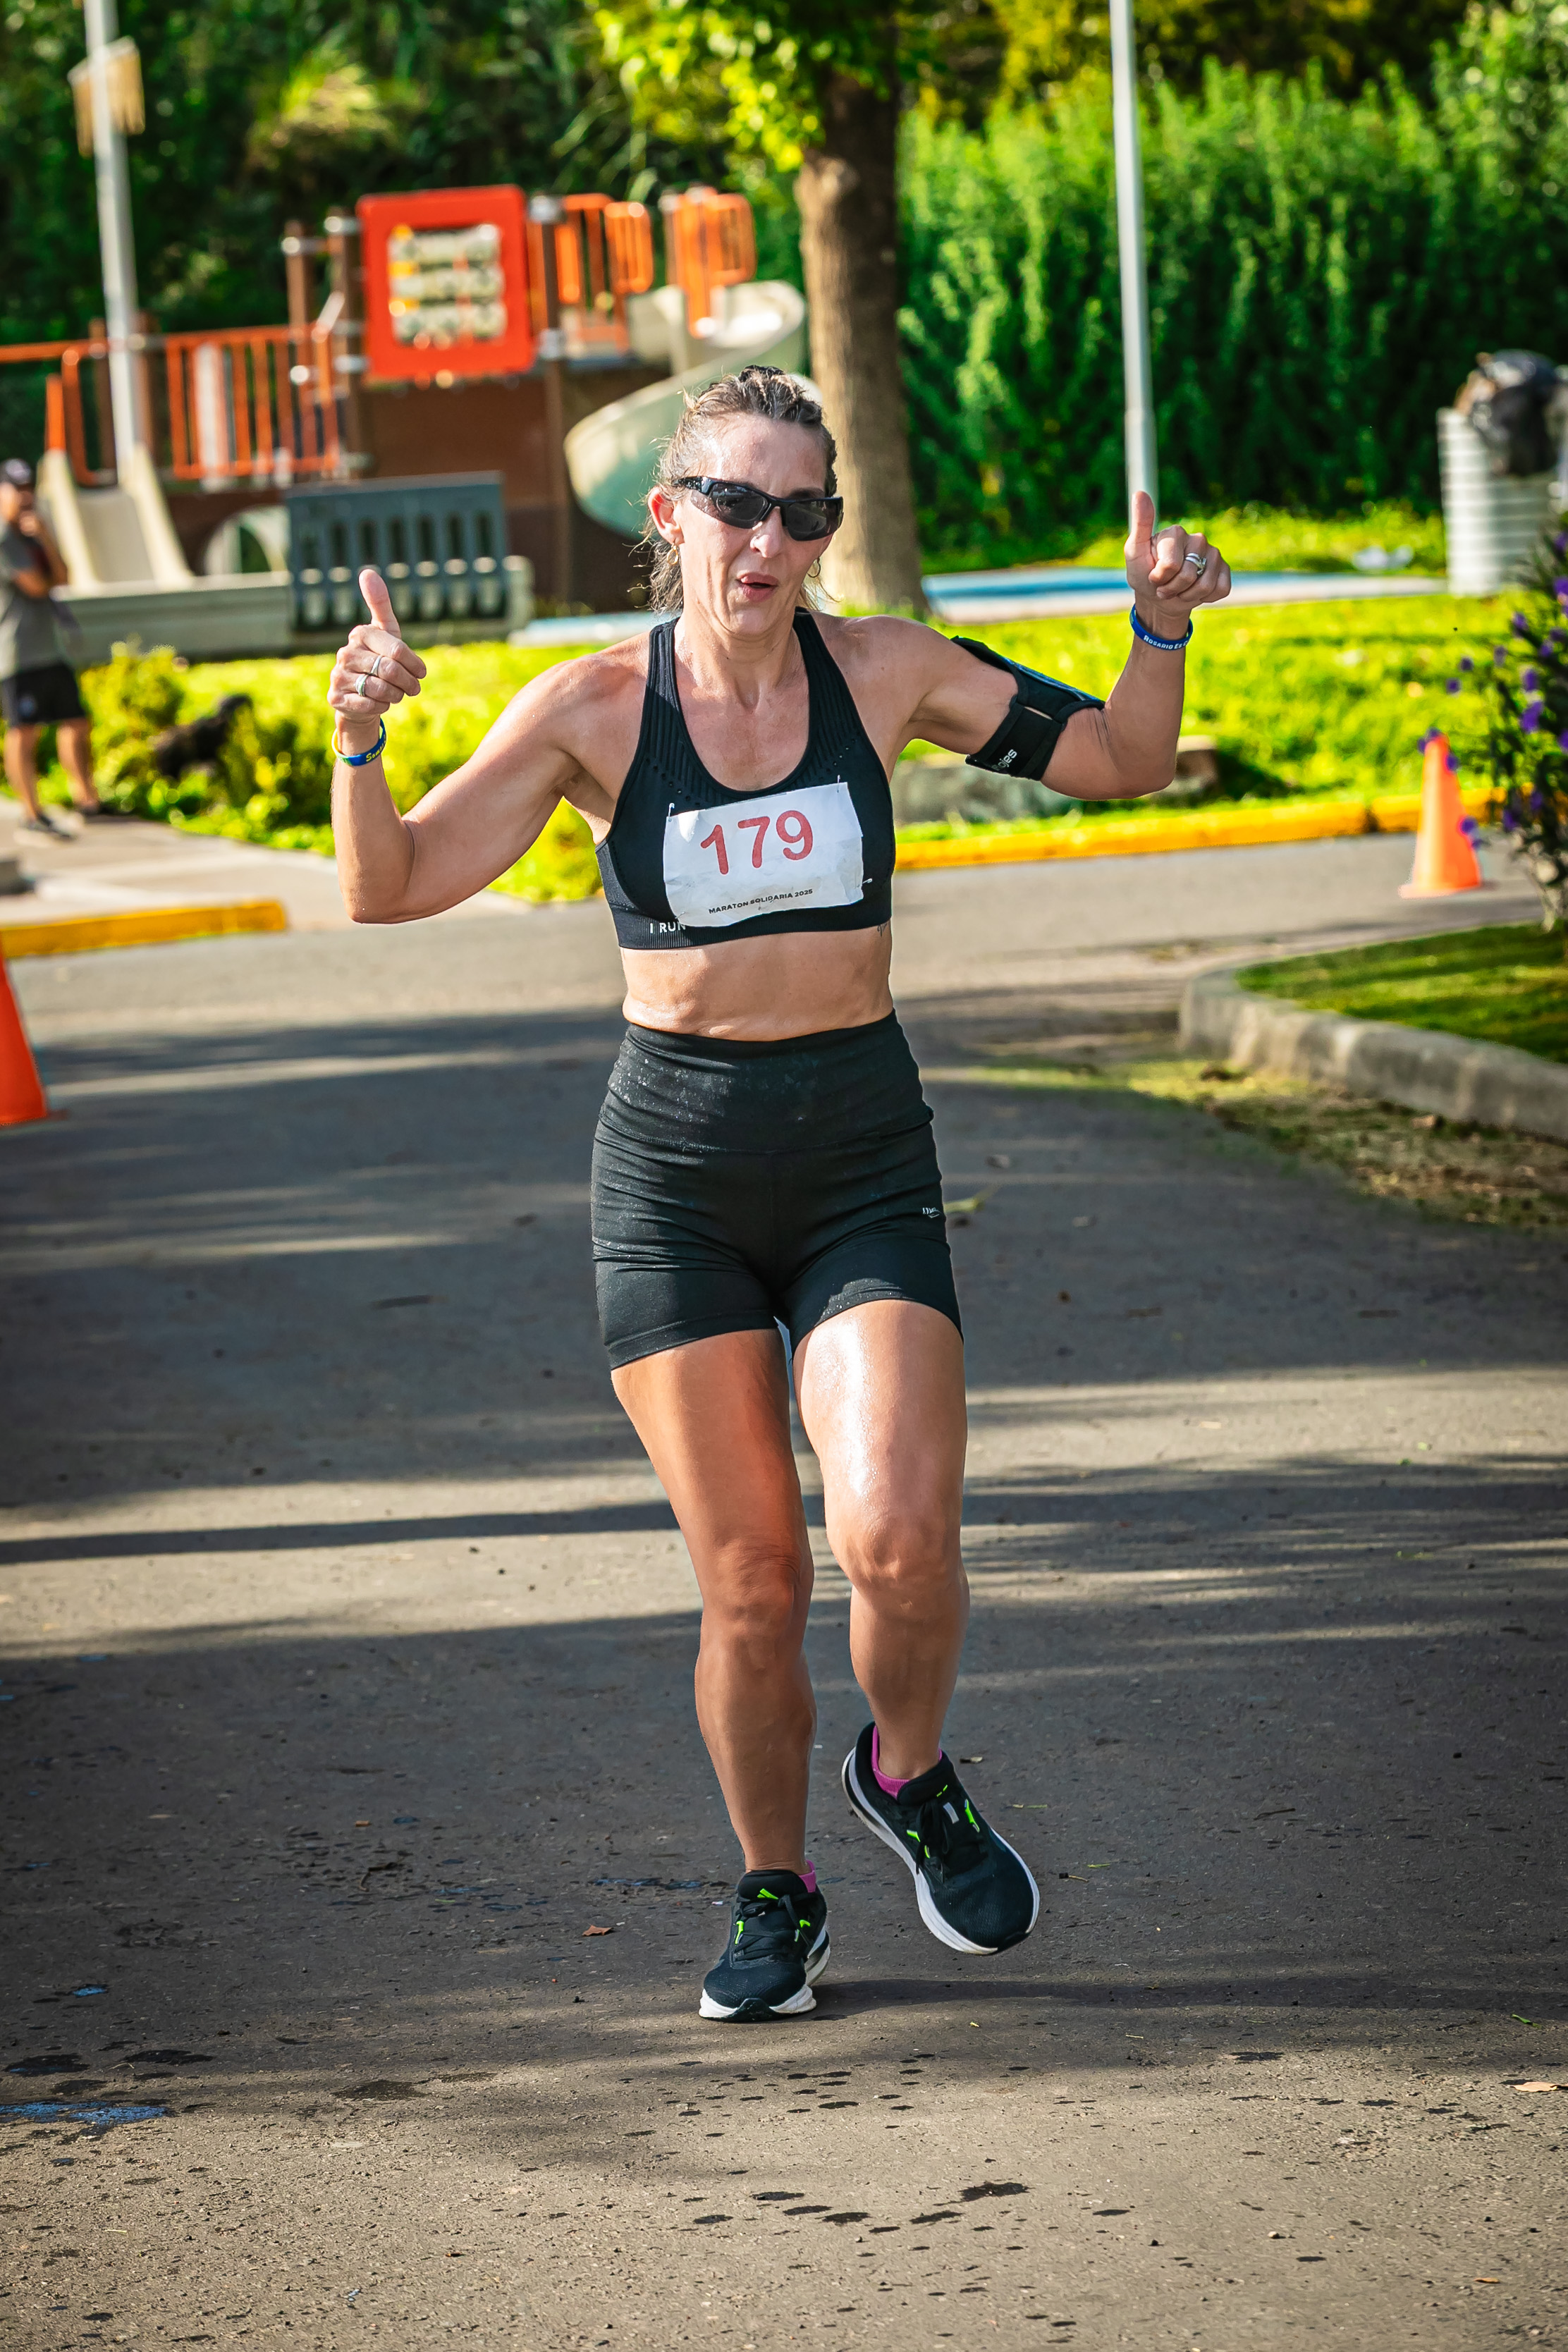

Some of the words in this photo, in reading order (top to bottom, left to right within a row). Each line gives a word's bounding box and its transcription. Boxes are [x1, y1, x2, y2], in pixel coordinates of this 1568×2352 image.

[700, 809, 814, 876] 179
[709, 902, 749, 914] MARATON
[750, 893, 793, 905] SOLIDARIA
[795, 888, 813, 898] 2025
[650, 922, 653, 934] I
[659, 921, 686, 933] RUN
